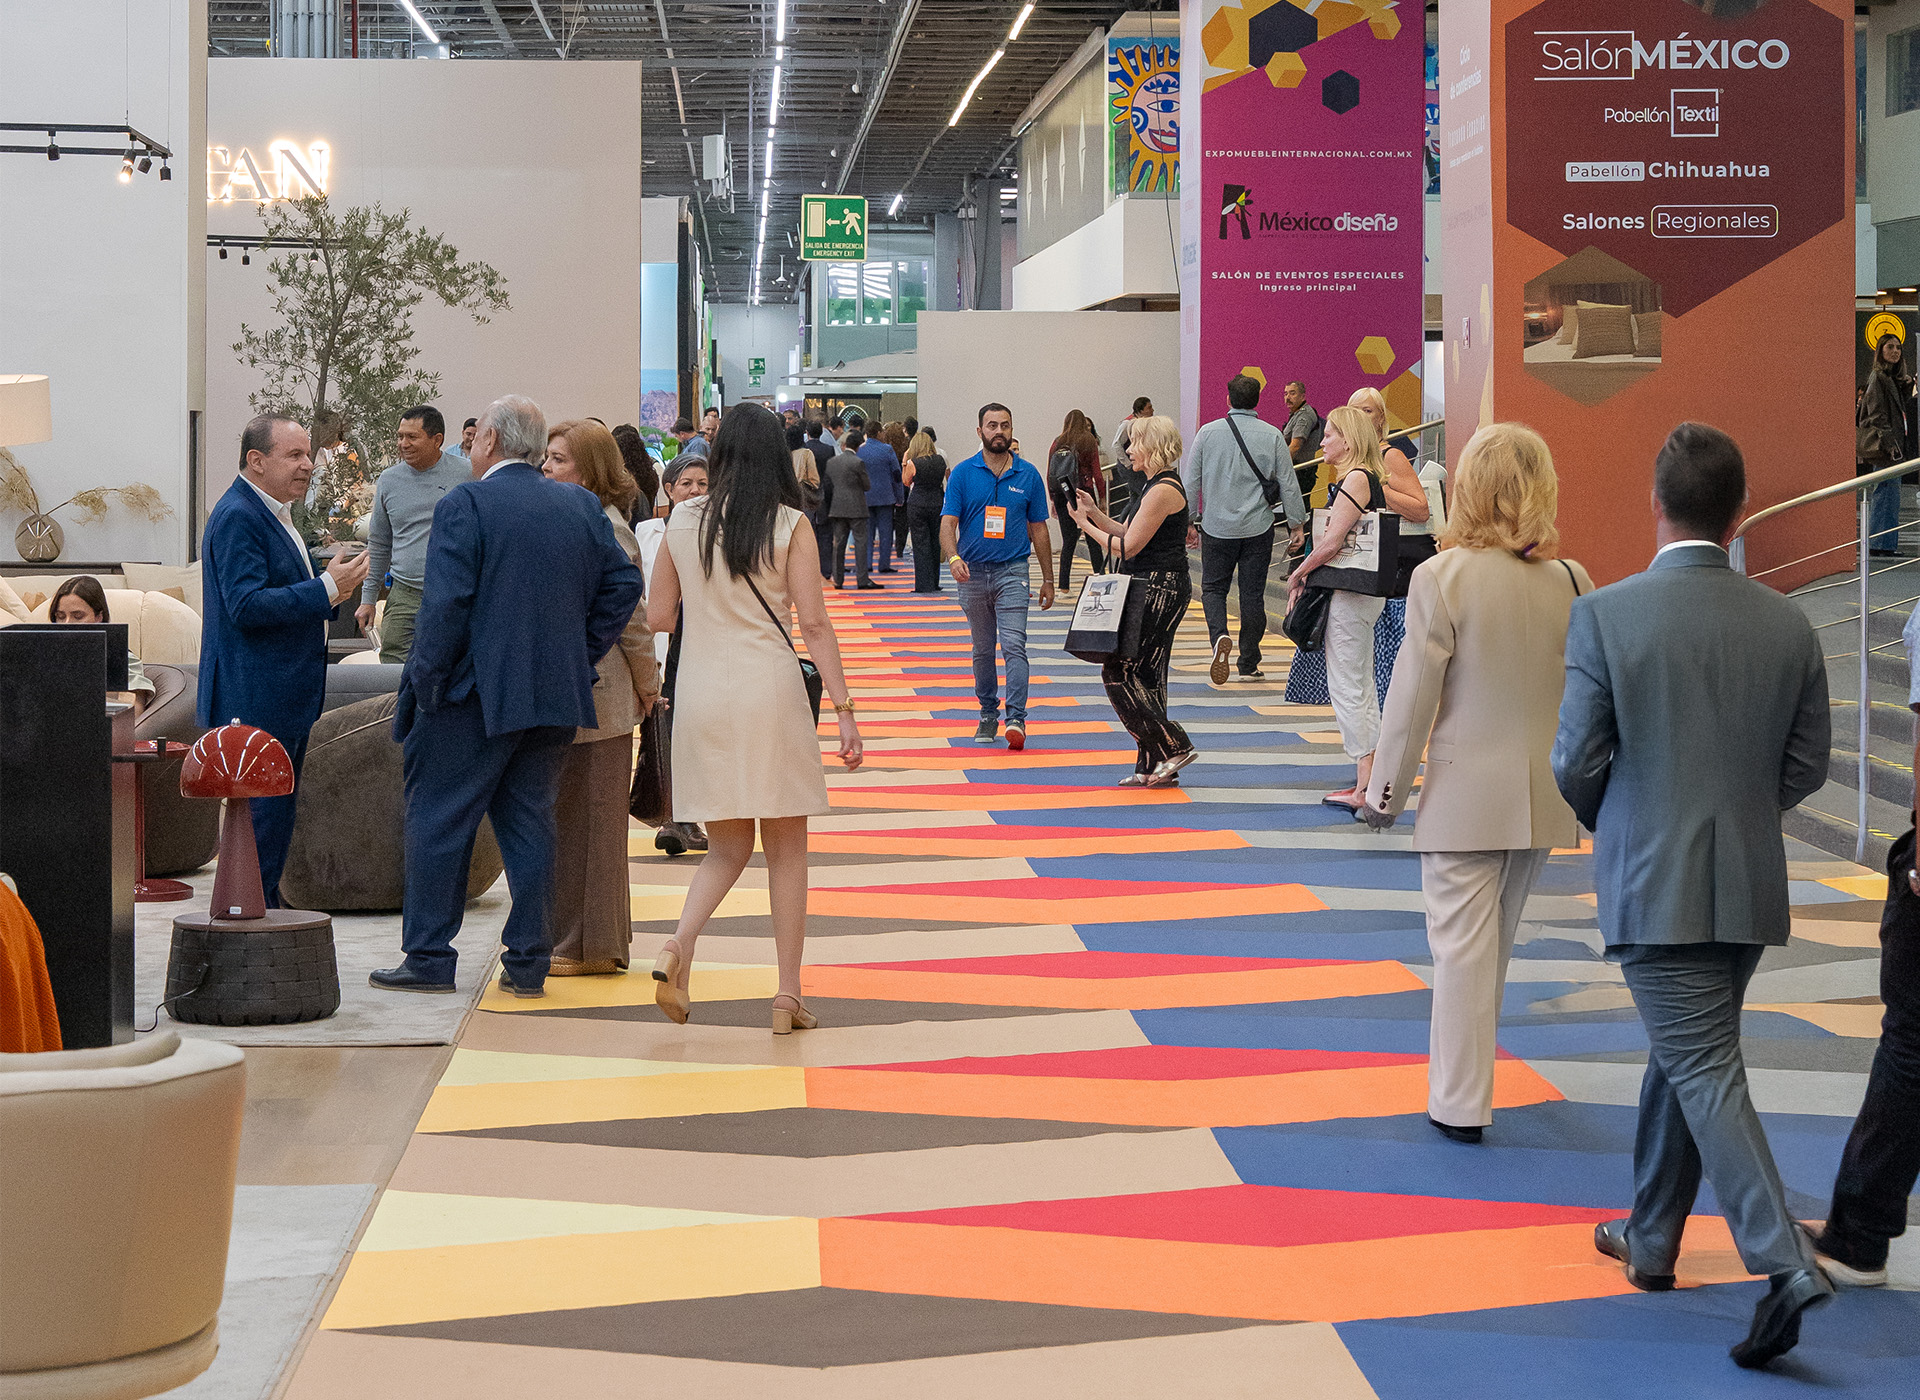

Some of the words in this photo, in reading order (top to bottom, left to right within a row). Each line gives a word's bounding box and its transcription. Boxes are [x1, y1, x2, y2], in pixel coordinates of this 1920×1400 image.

[1604, 106, 1670, 123] Pabellón
[1676, 105, 1719, 122] Textil
[1204, 150, 1414, 158] EXPOMUEBLEINTERNACIONAL.COM.MX
[1569, 165, 1641, 178] Pabellón
[1648, 160, 1771, 178] Chihuahua
[1562, 212, 1646, 230] Salones
[1656, 211, 1772, 233] Regionales
[832, 242, 864, 250] EMERGENCIA
[1211, 270, 1251, 280] SALÓN
[1255, 271, 1271, 280] DE
[1275, 271, 1330, 280] EVENTOS
[1333, 271, 1405, 280] ESPECIALES
[1259, 283, 1302, 293] Ingreso
[1306, 283, 1357, 293] principal
